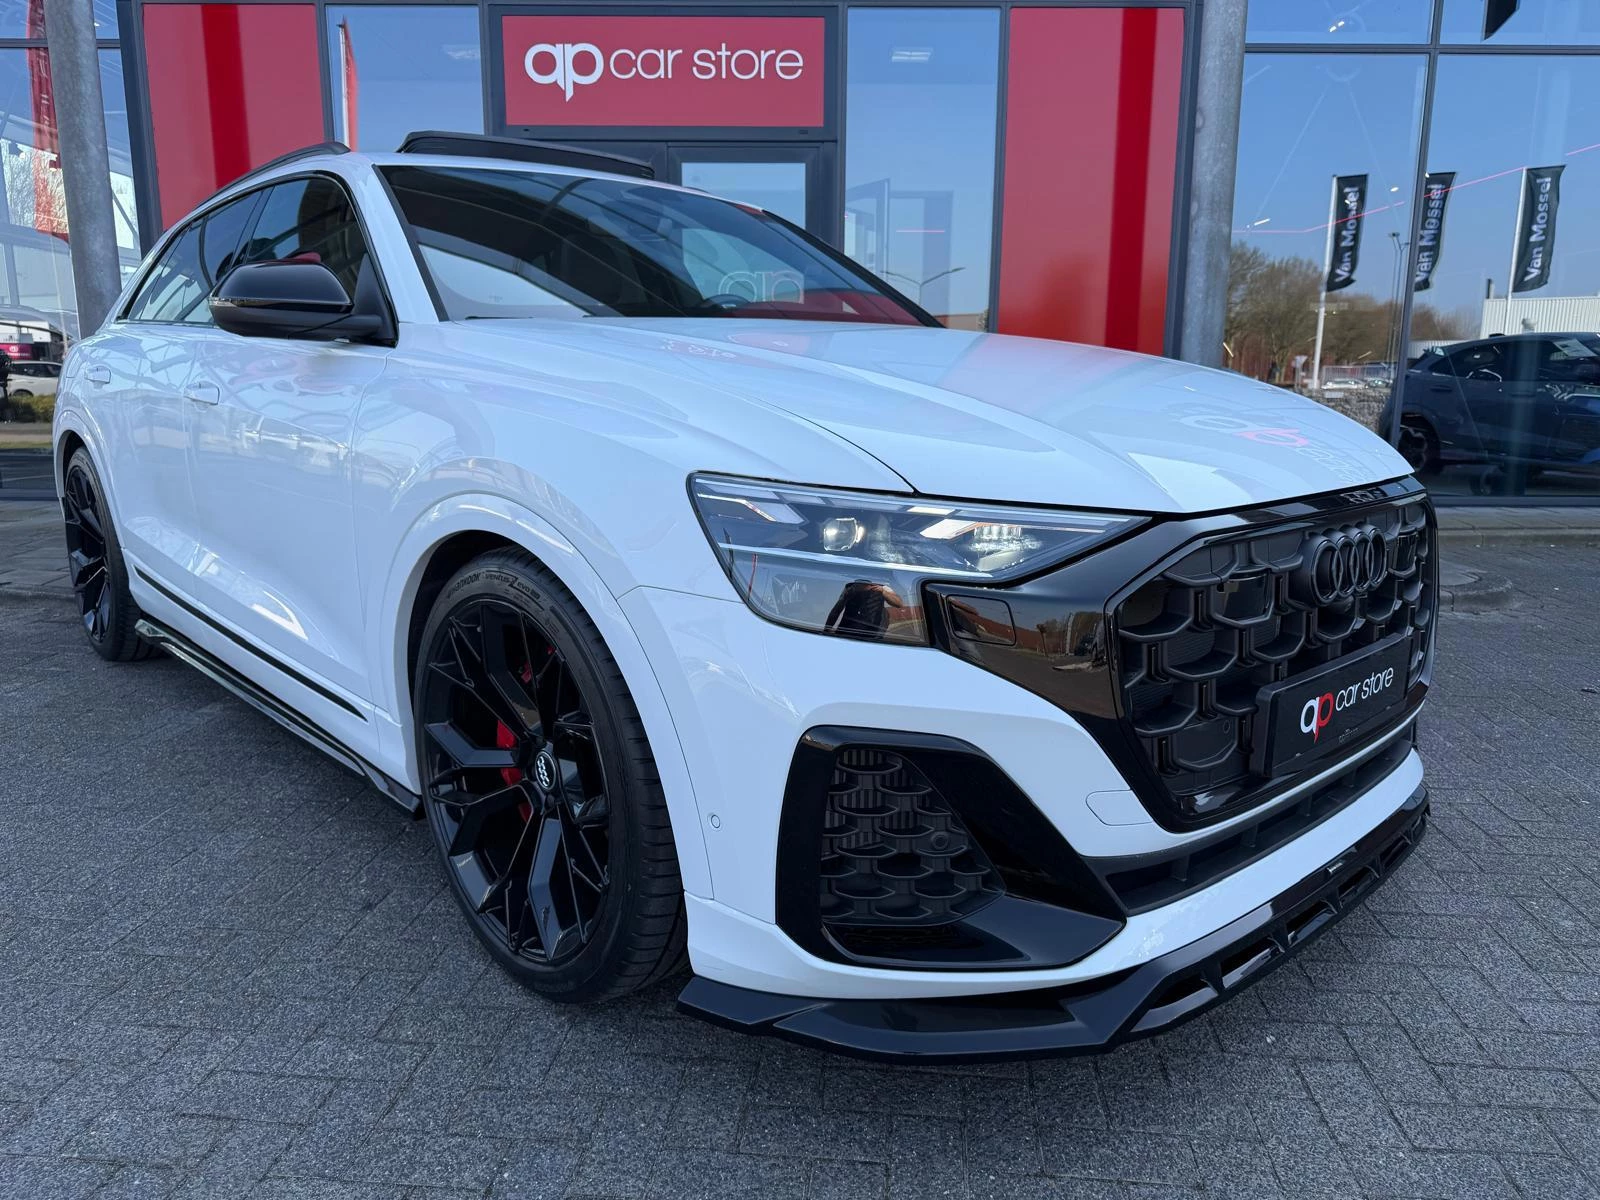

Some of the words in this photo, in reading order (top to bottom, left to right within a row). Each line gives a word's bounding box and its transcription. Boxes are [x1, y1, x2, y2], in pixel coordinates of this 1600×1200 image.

[524, 42, 604, 103] ap
[609, 48, 683, 80] car
[692, 42, 804, 80] store
[1340, 186, 1360, 247] Mossel
[1419, 183, 1447, 247] Mossel
[1529, 177, 1552, 242] Mossel
[1334, 251, 1353, 282] Van
[1414, 251, 1434, 282] Van
[1523, 246, 1544, 282] Van
[1300, 692, 1335, 744] ap
[1335, 682, 1361, 712] car
[1361, 667, 1394, 699] store
